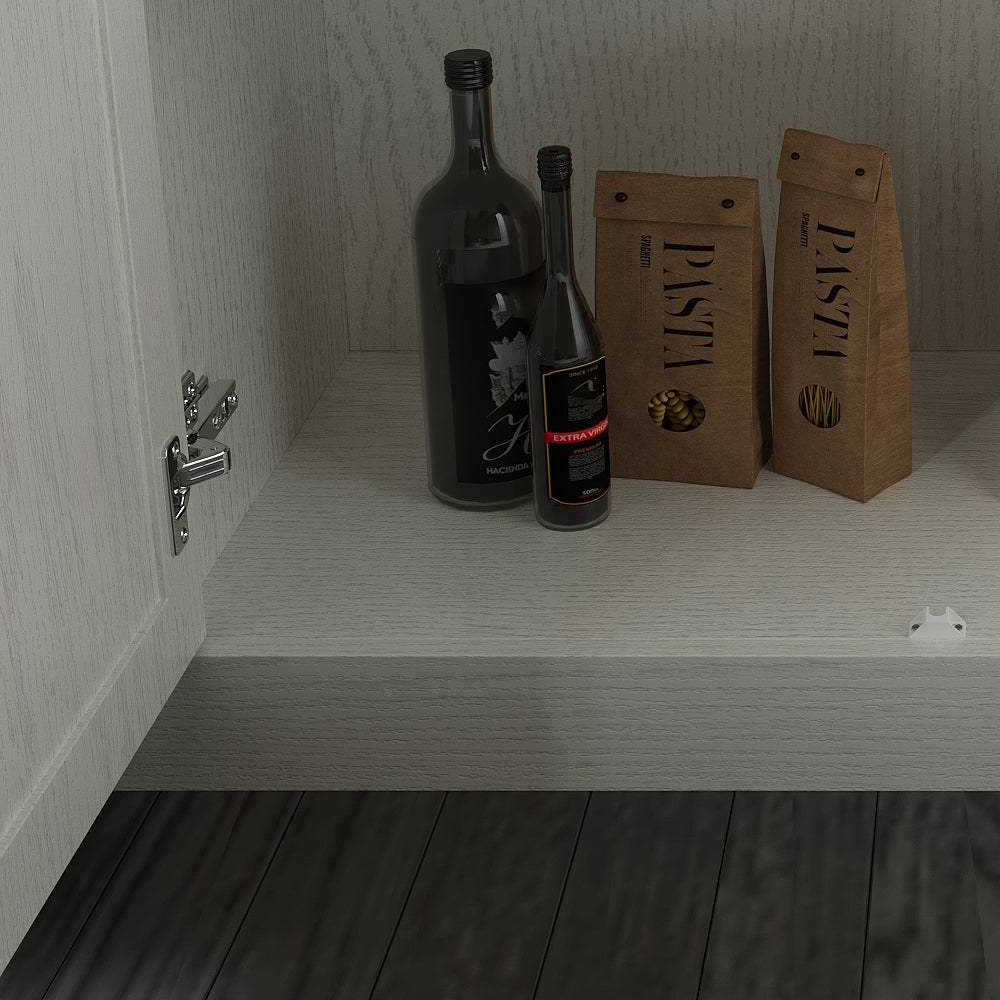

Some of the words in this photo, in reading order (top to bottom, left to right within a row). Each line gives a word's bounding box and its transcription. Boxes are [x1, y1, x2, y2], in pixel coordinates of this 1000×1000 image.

[800, 212, 811, 247] SPAGHETTI
[640, 235, 652, 268] SPAGHETTI
[663, 238, 715, 369] PASTA
[813, 217, 856, 358] PASTA
[553, 432, 587, 442] EXTRA
[486, 463, 529, 475] HACIENDA
